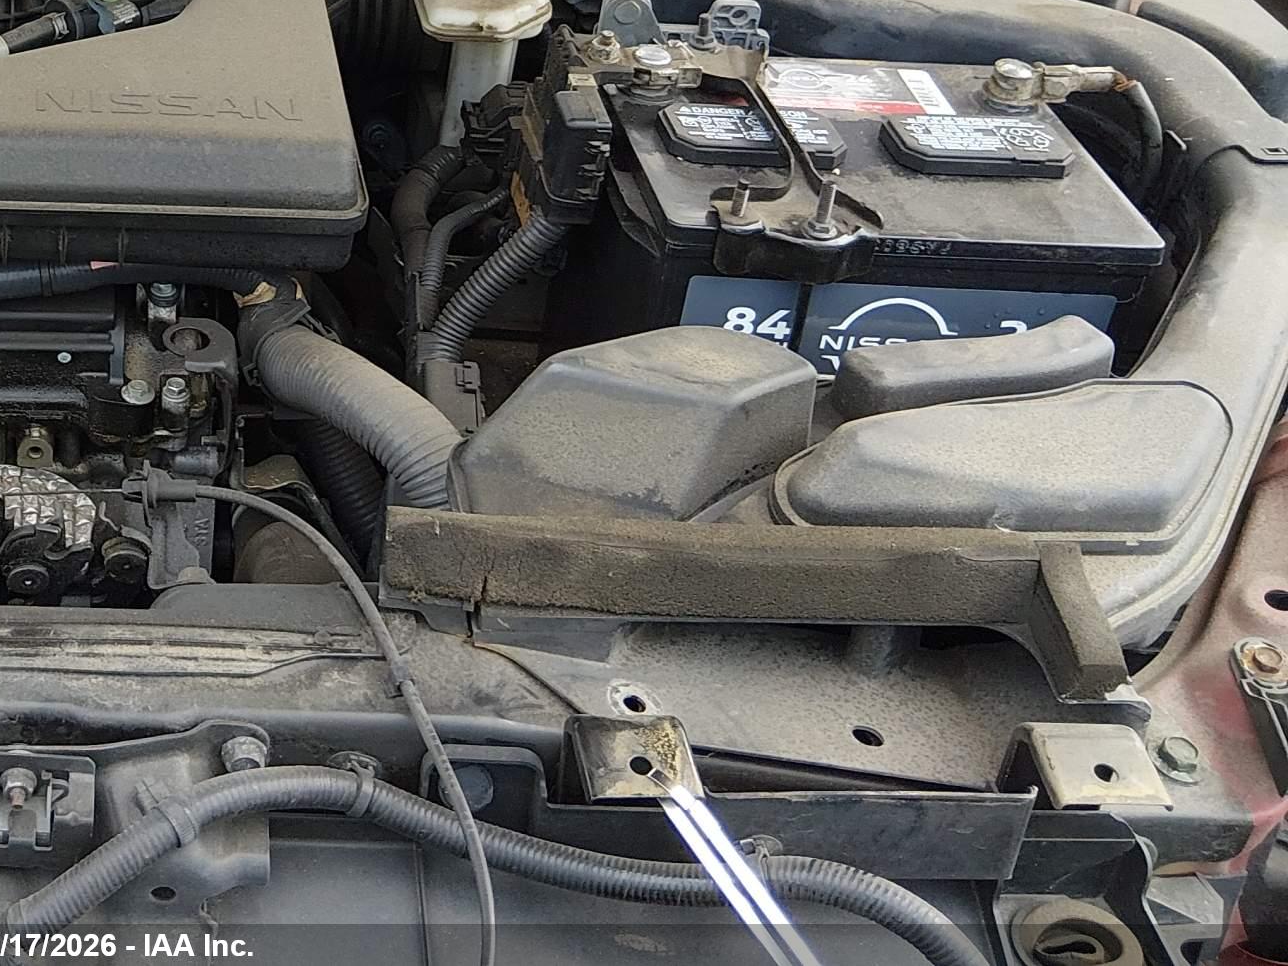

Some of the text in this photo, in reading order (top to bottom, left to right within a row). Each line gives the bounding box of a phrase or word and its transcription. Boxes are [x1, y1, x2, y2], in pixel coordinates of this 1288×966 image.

[35, 88, 303, 122] NISSAN
[722, 306, 792, 340] 84
[819, 334, 908, 352] NIS
